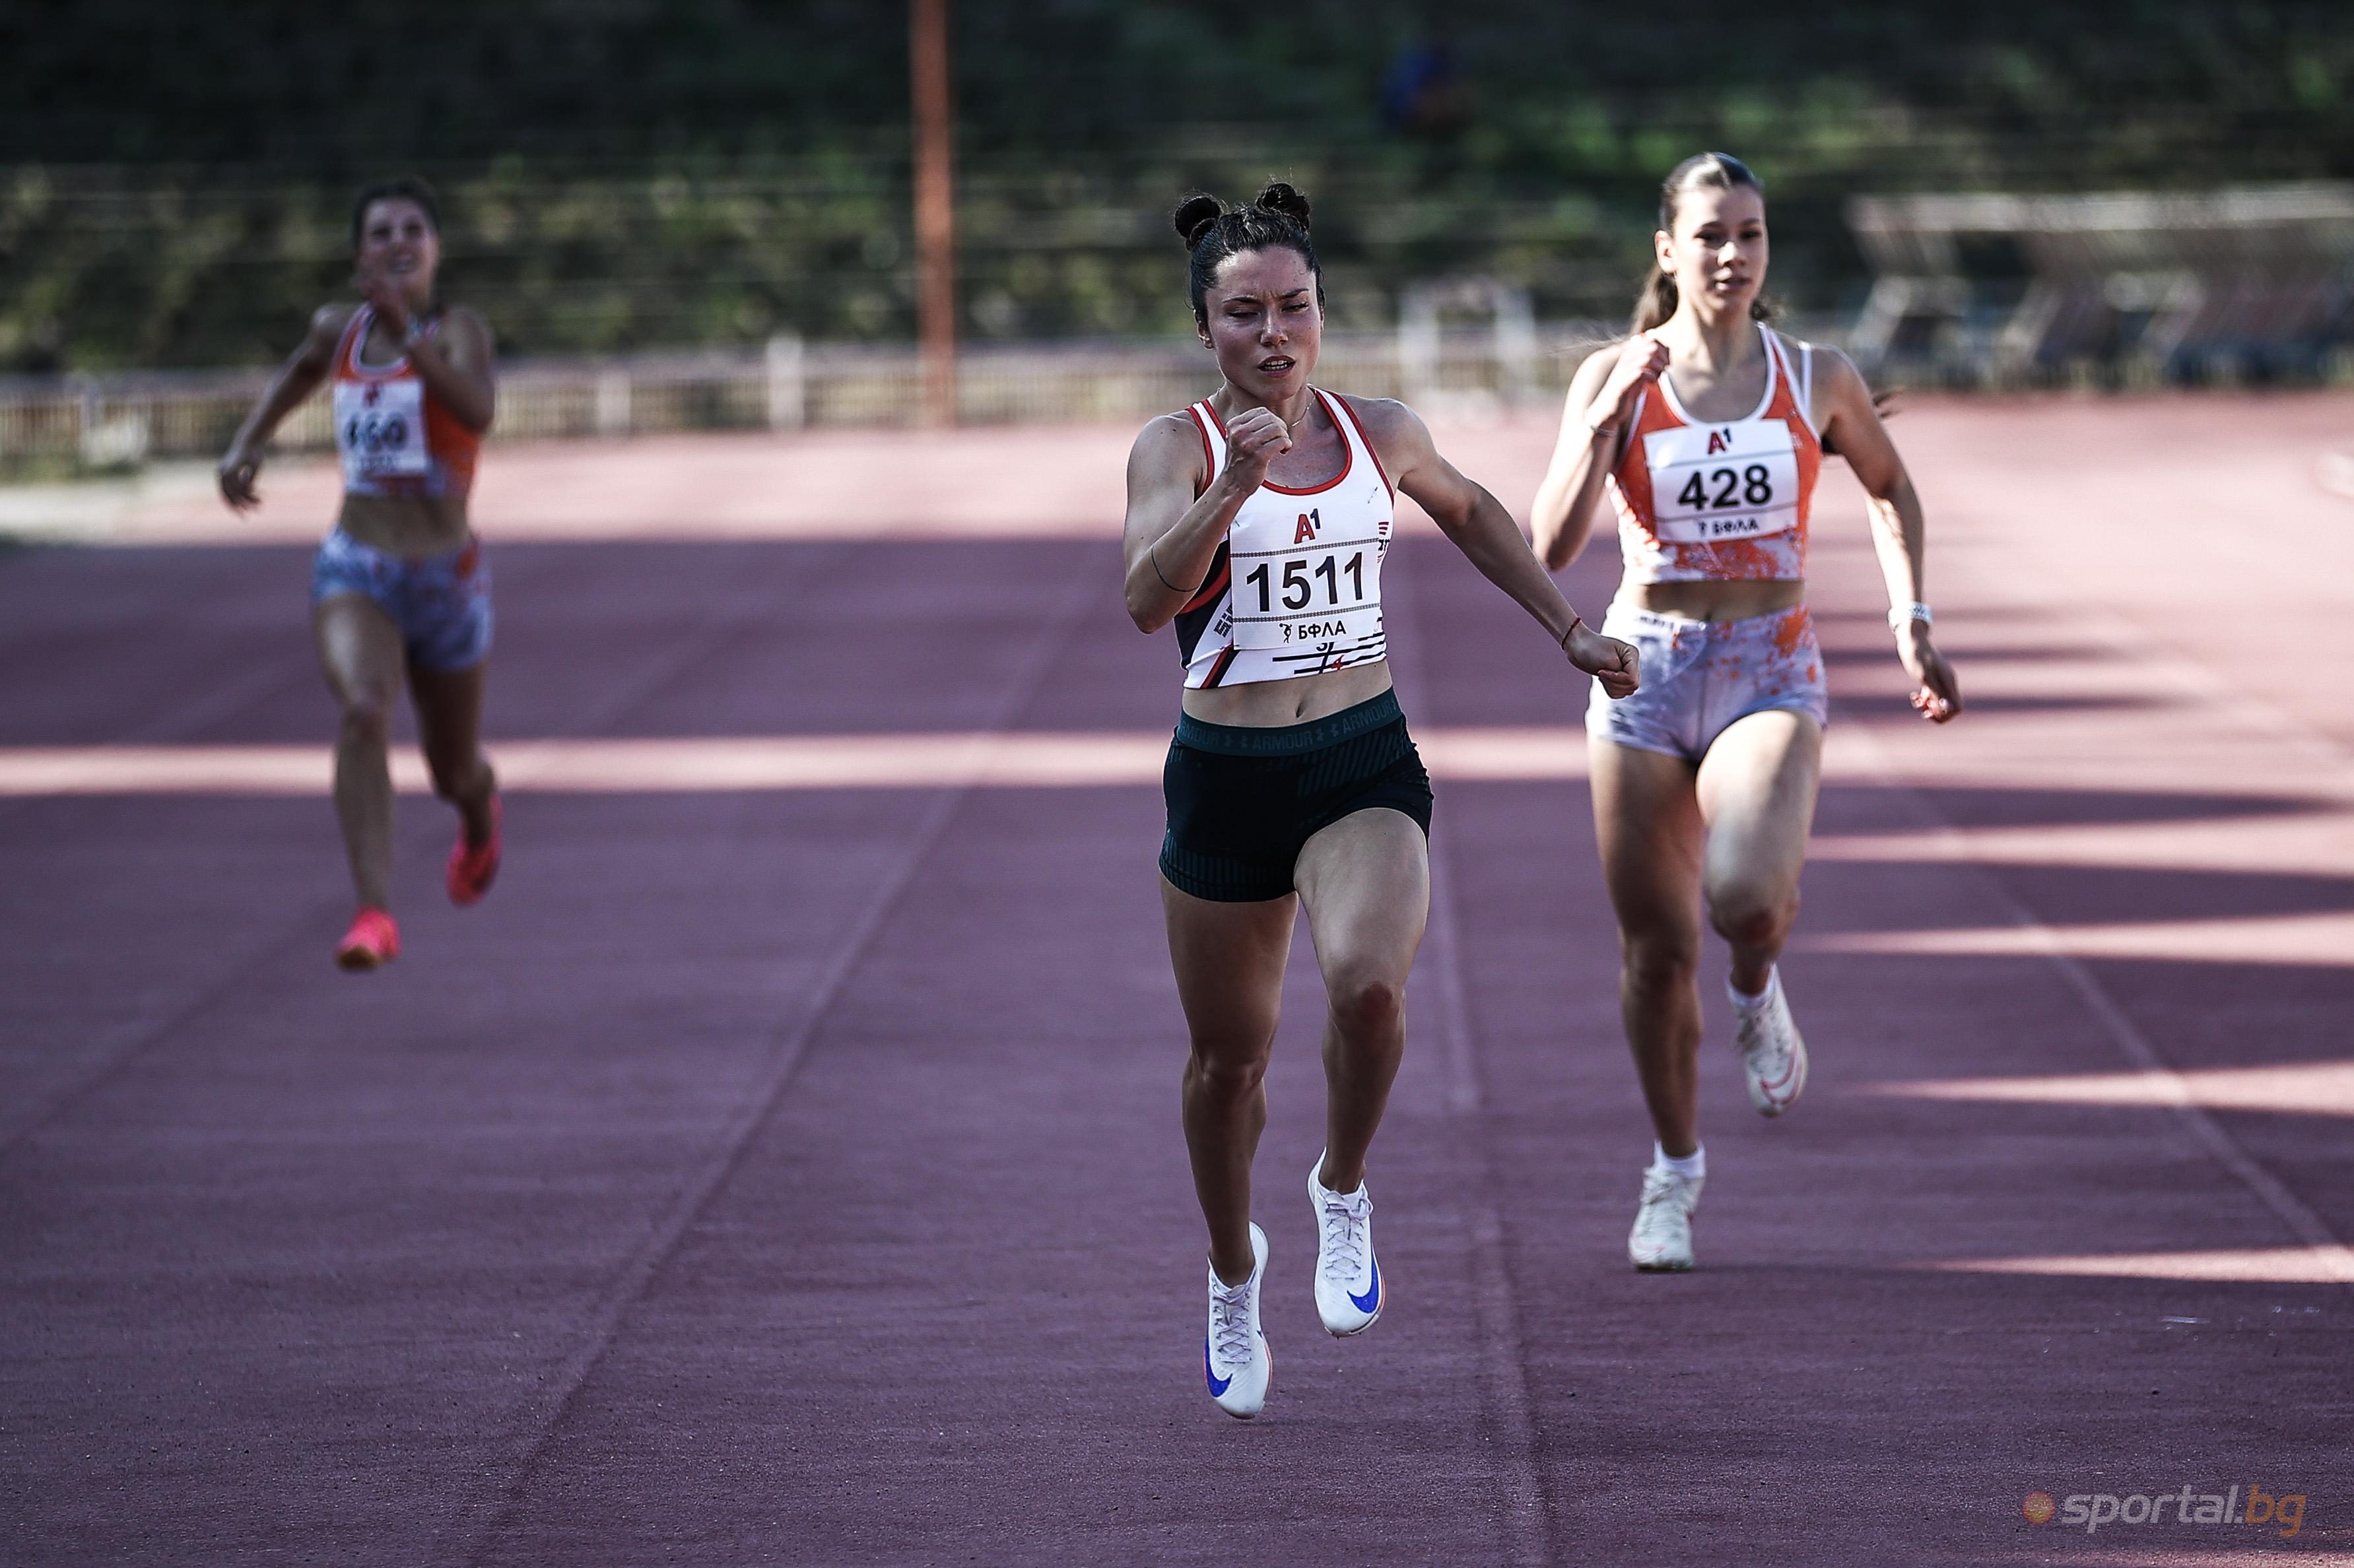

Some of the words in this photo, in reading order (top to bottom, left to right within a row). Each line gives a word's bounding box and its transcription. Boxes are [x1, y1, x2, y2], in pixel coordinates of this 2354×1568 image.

[1708, 428, 1732, 455] A1
[1677, 465, 1772, 511] 428
[1294, 508, 1321, 544] A1
[1246, 552, 1362, 612] 1511
[1298, 620, 1347, 639] БФЛА
[1179, 720, 1220, 747] RMOUR
[1253, 730, 1313, 751] ARMOUR
[1342, 701, 1393, 734] ARMOUR
